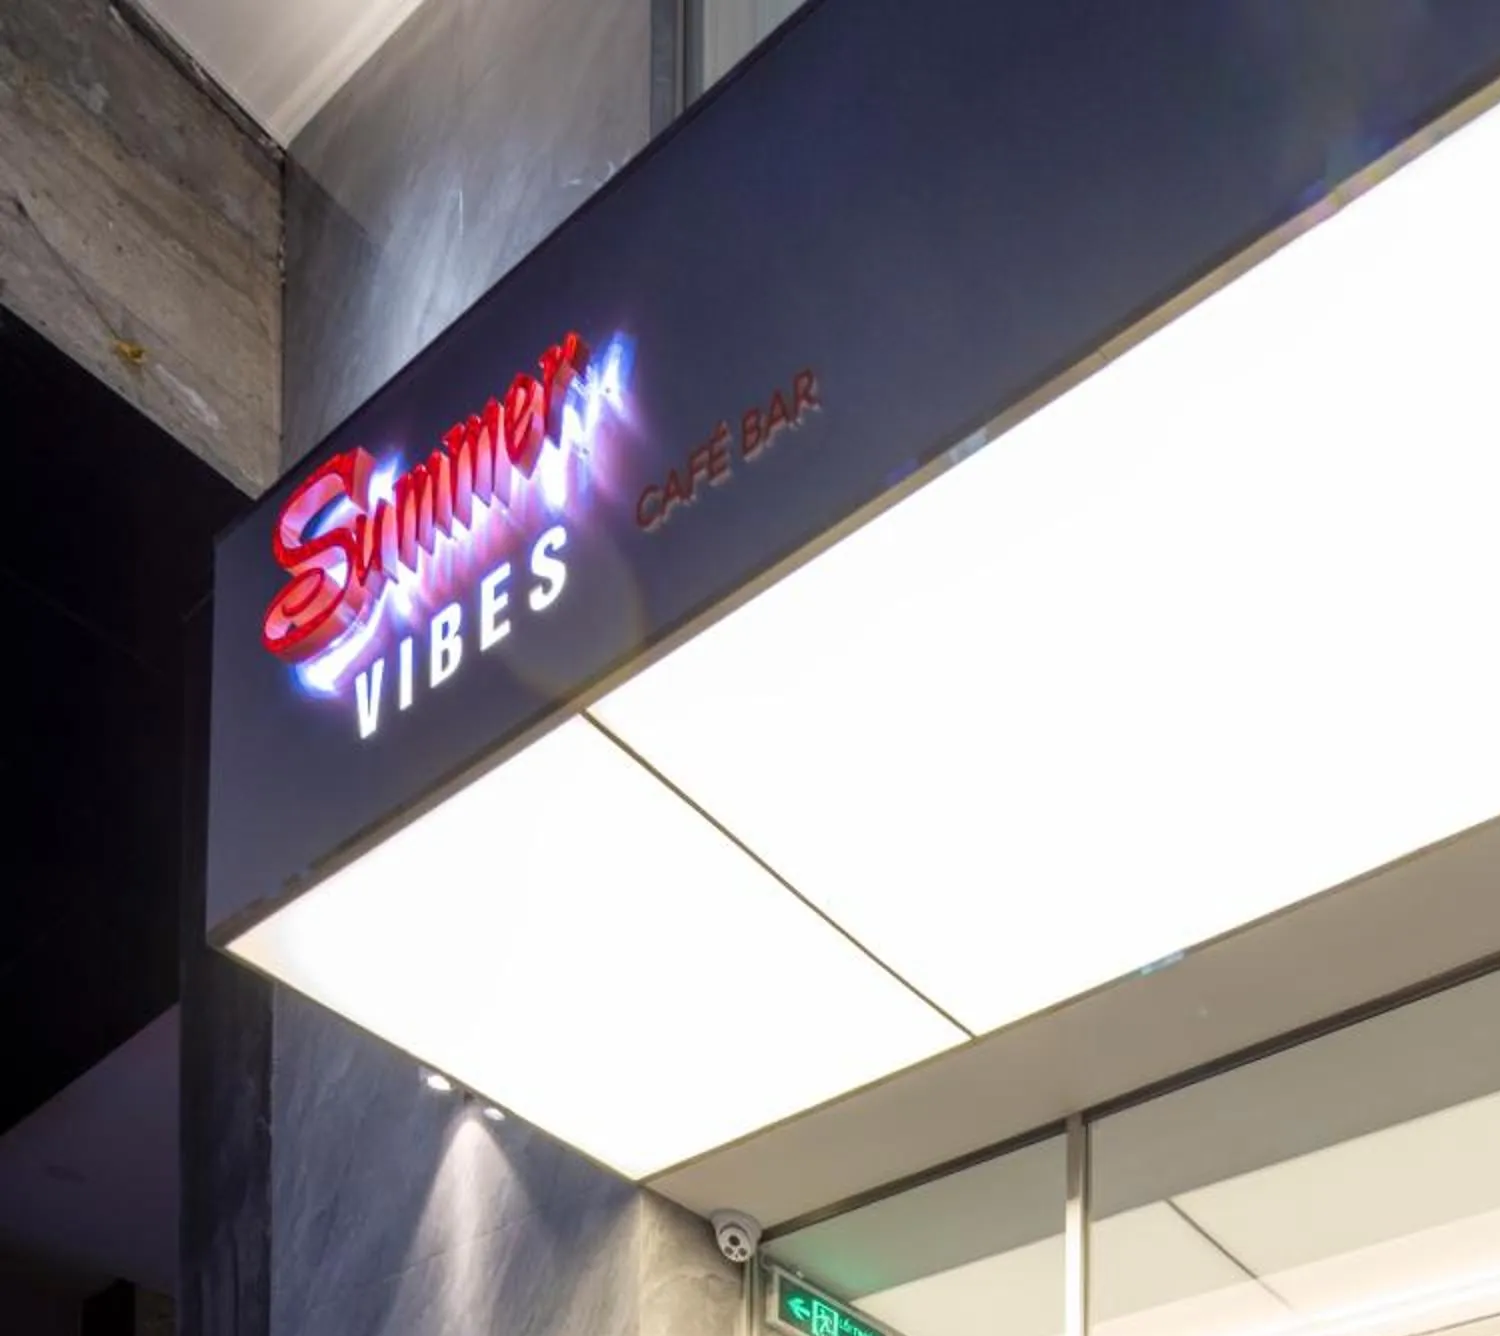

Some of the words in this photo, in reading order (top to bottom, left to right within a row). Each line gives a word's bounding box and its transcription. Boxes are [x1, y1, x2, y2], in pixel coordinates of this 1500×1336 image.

[262, 331, 590, 662] Summer
[636, 419, 732, 533] CAFÉ
[742, 367, 824, 463] BAR
[353, 524, 568, 740] VIBES
